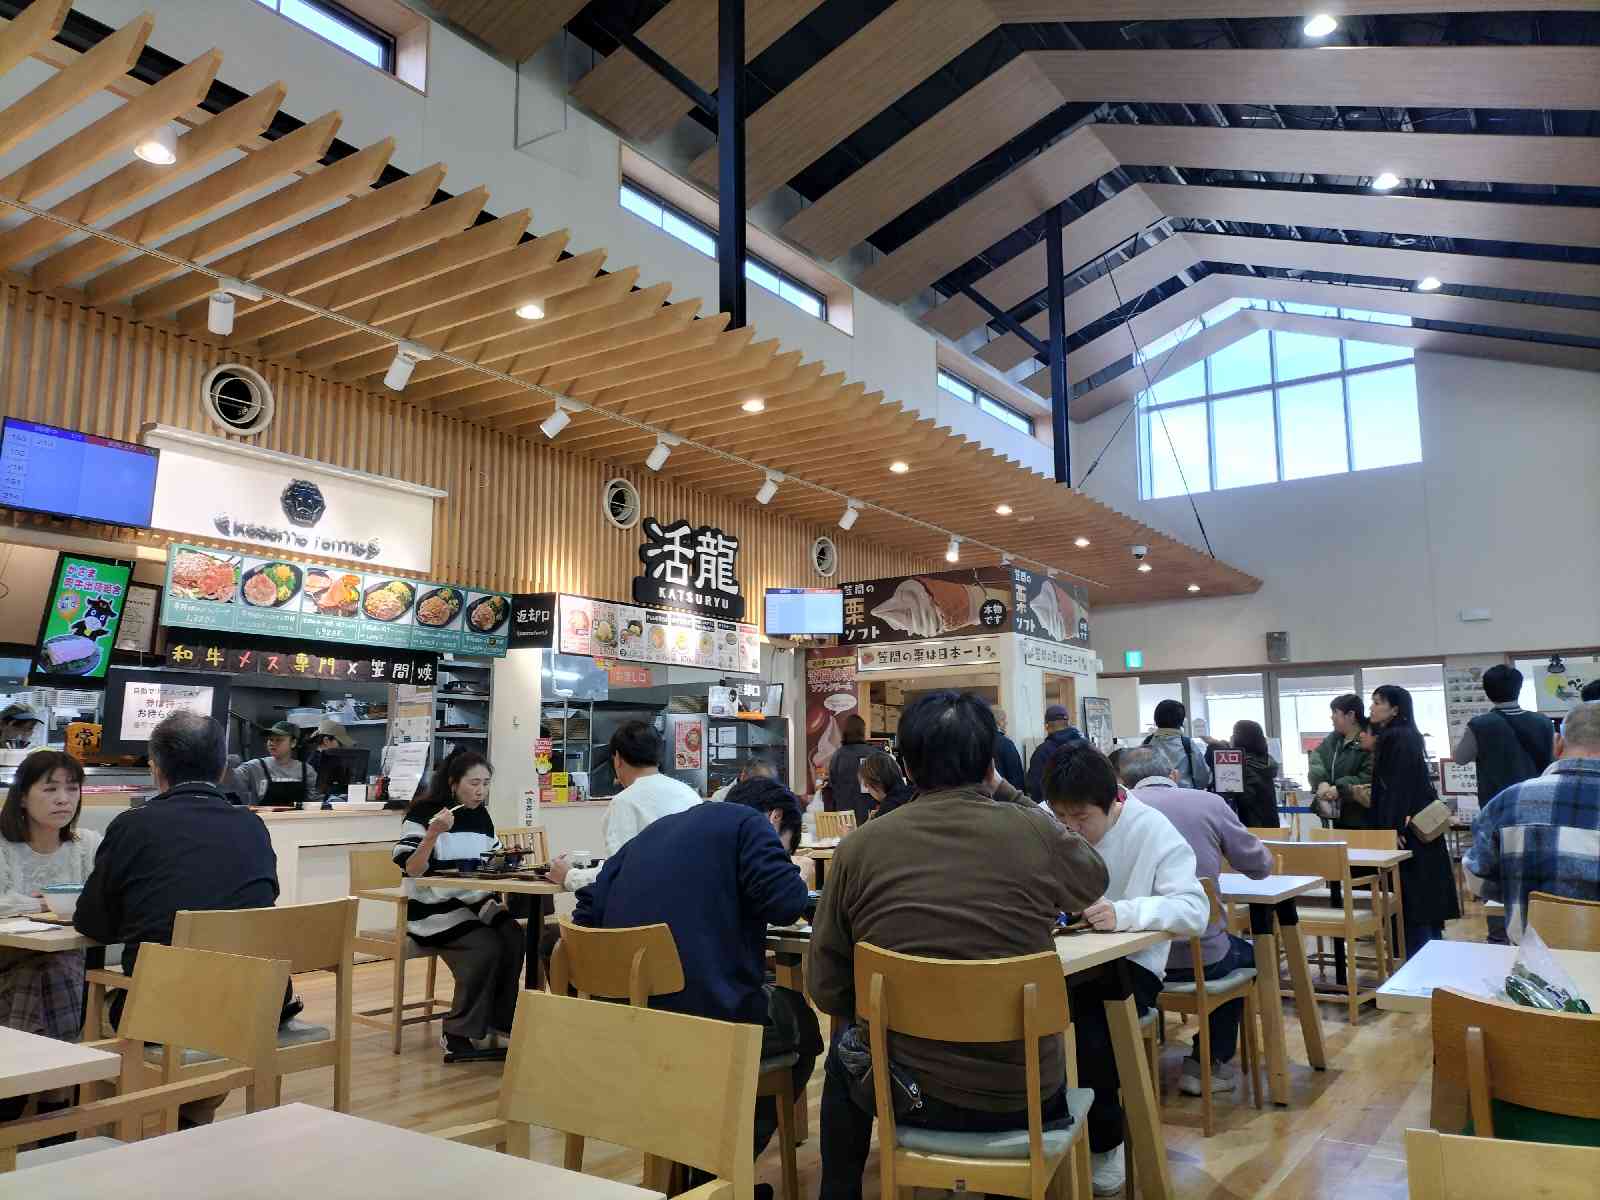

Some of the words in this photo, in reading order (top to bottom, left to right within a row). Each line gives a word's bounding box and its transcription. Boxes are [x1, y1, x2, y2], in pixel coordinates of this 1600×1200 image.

[647, 523, 739, 594] 活龍
[843, 583, 875, 597] 笠間の
[658, 587, 729, 609] KATSURYU
[516, 608, 550, 623] 返却口
[845, 597, 864, 625] 栗
[983, 615, 1003, 626] です
[845, 626, 881, 641] ソフト
[1218, 753, 1240, 764] 入口
